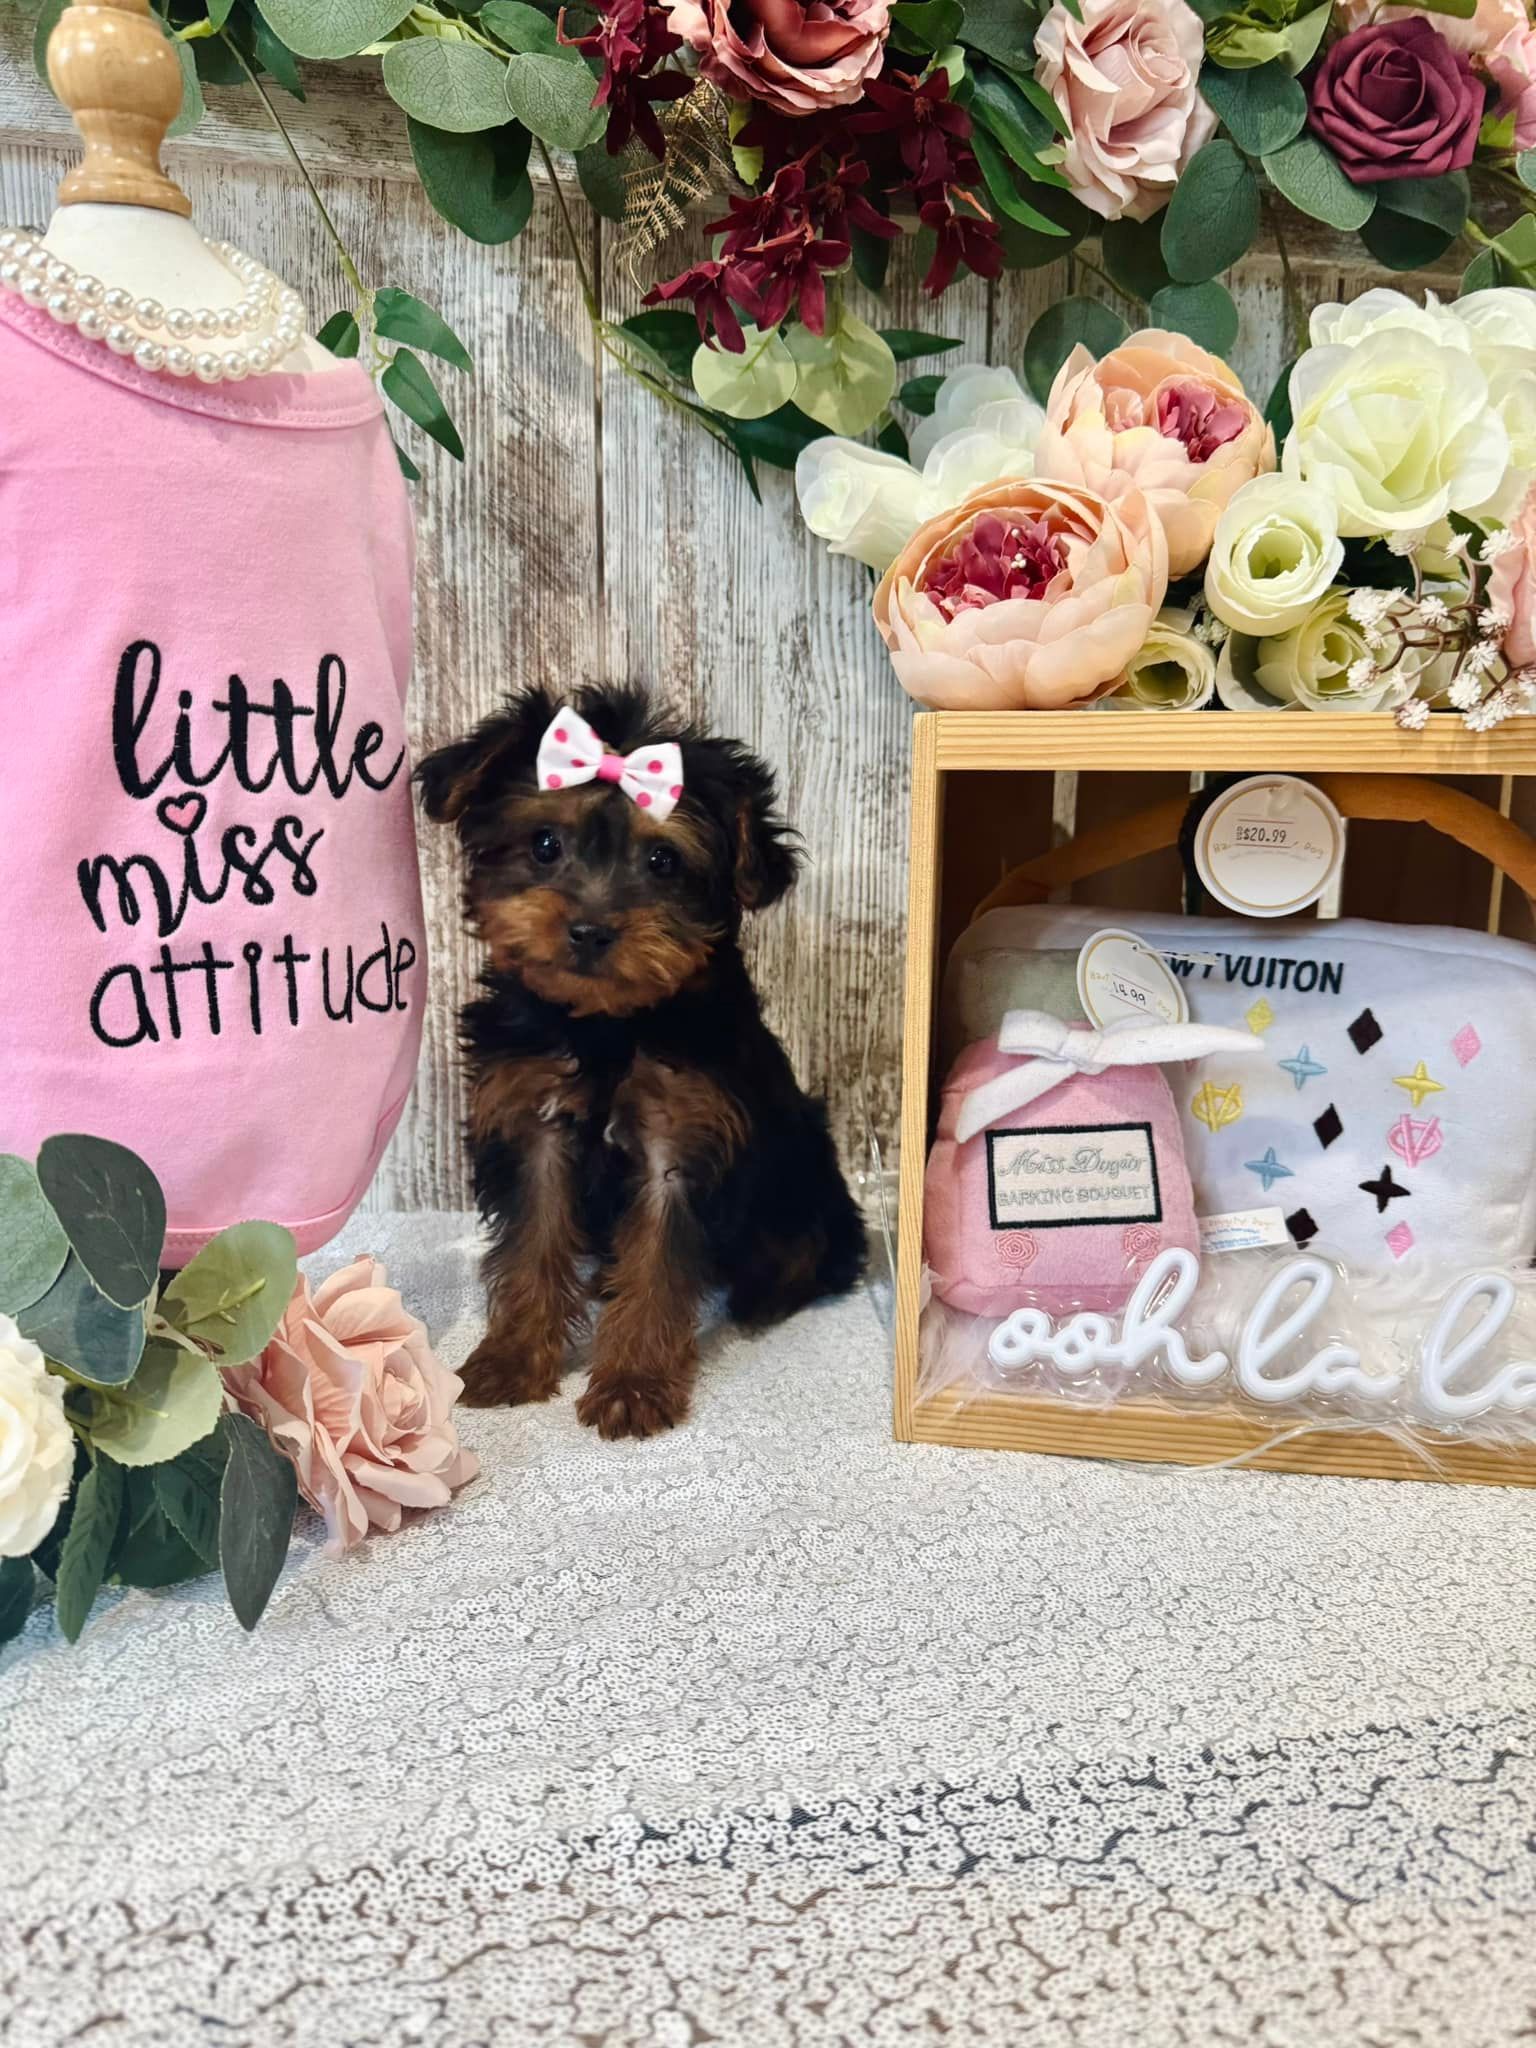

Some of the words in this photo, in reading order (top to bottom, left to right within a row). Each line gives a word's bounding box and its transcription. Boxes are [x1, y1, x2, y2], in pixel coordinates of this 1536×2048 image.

[113, 640, 405, 799] little
[77, 792, 324, 938] miss
[90, 922, 416, 1049] attitude
[1224, 953, 1345, 995] VUITON
[997, 1148, 1066, 1177] Miss
[997, 1186, 1074, 1207] BARKING
[1075, 1184, 1151, 1204] BOUQUET
[988, 1246, 1230, 1385] ooh
[1238, 1257, 1400, 1402] la
